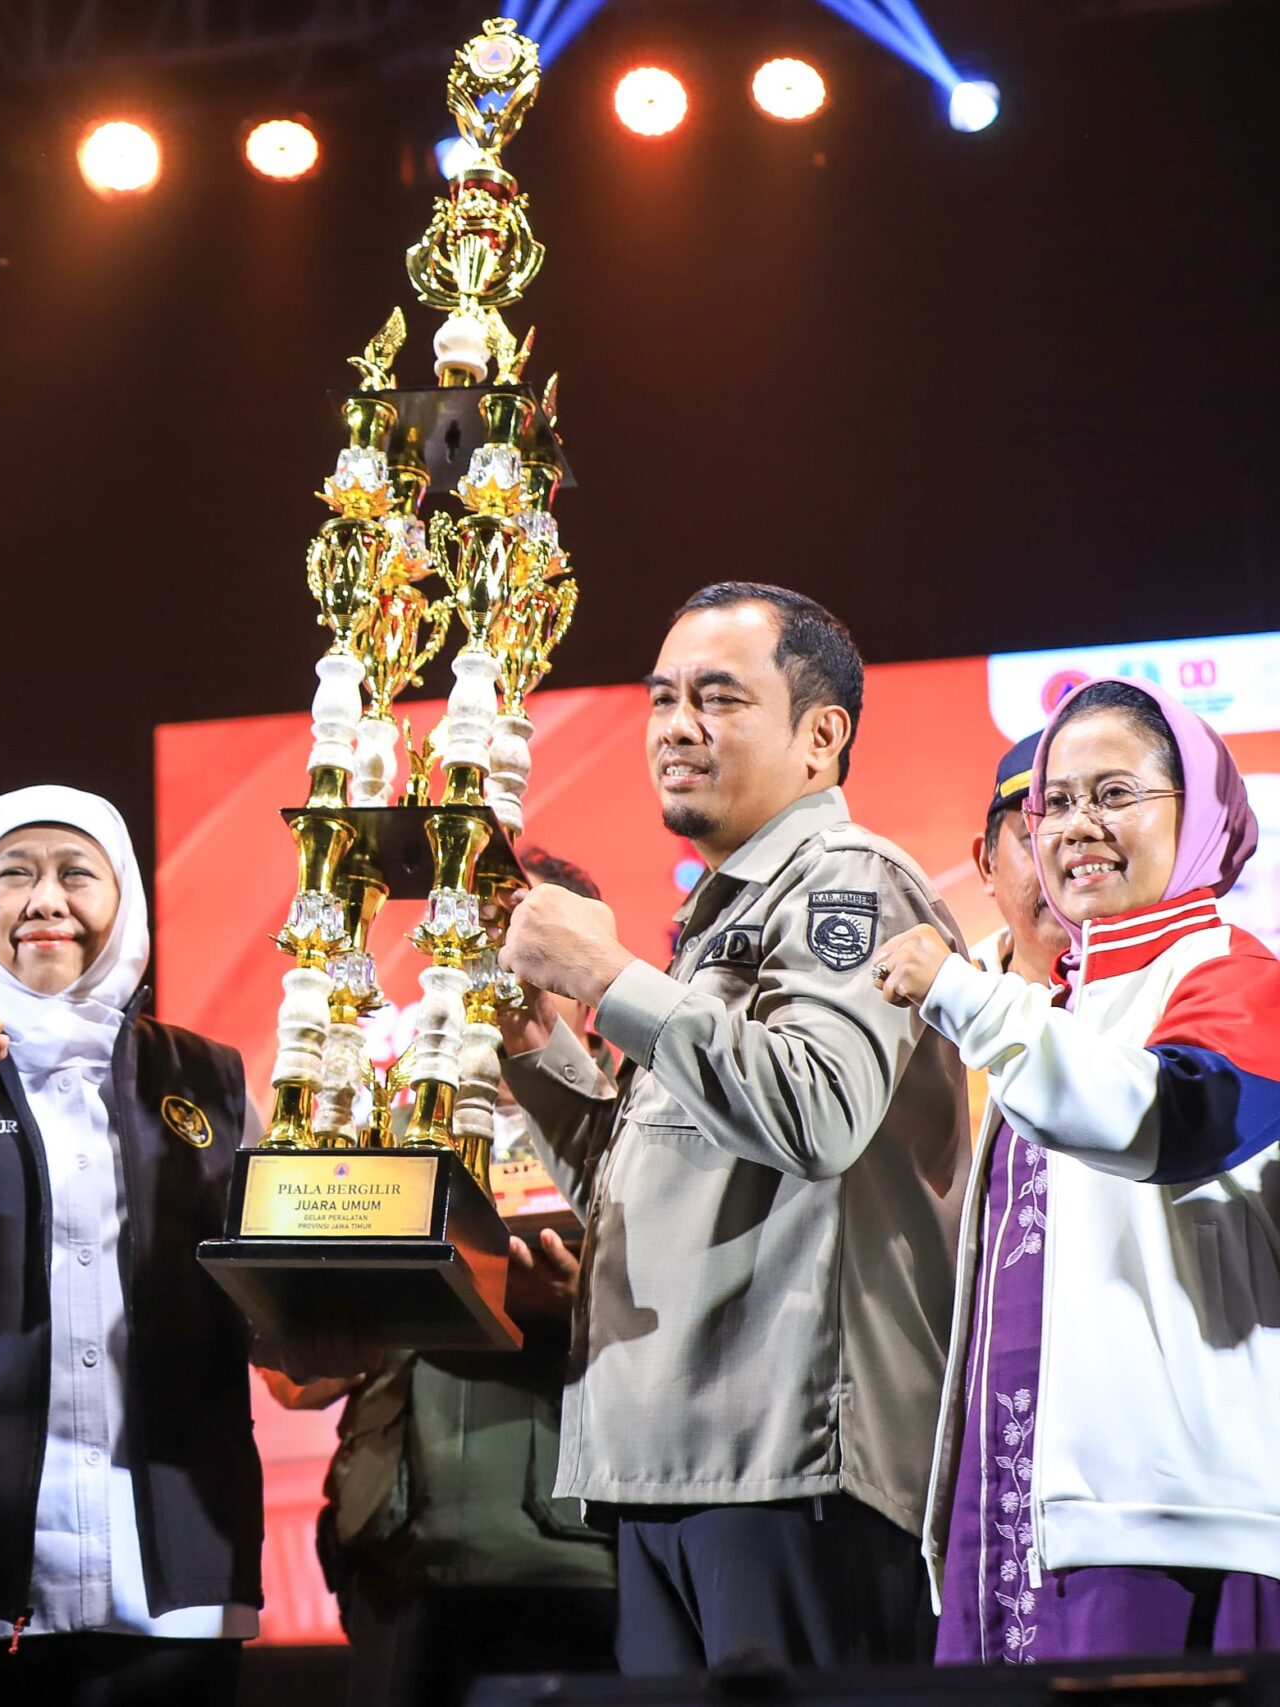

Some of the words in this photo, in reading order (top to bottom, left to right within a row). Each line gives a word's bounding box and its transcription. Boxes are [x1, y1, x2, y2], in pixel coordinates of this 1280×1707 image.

[278, 1183, 322, 1195] PIALA
[326, 1183, 401, 1195] BERGILIR
[294, 1200, 337, 1211] JUARA
[341, 1200, 382, 1211] UMUM
